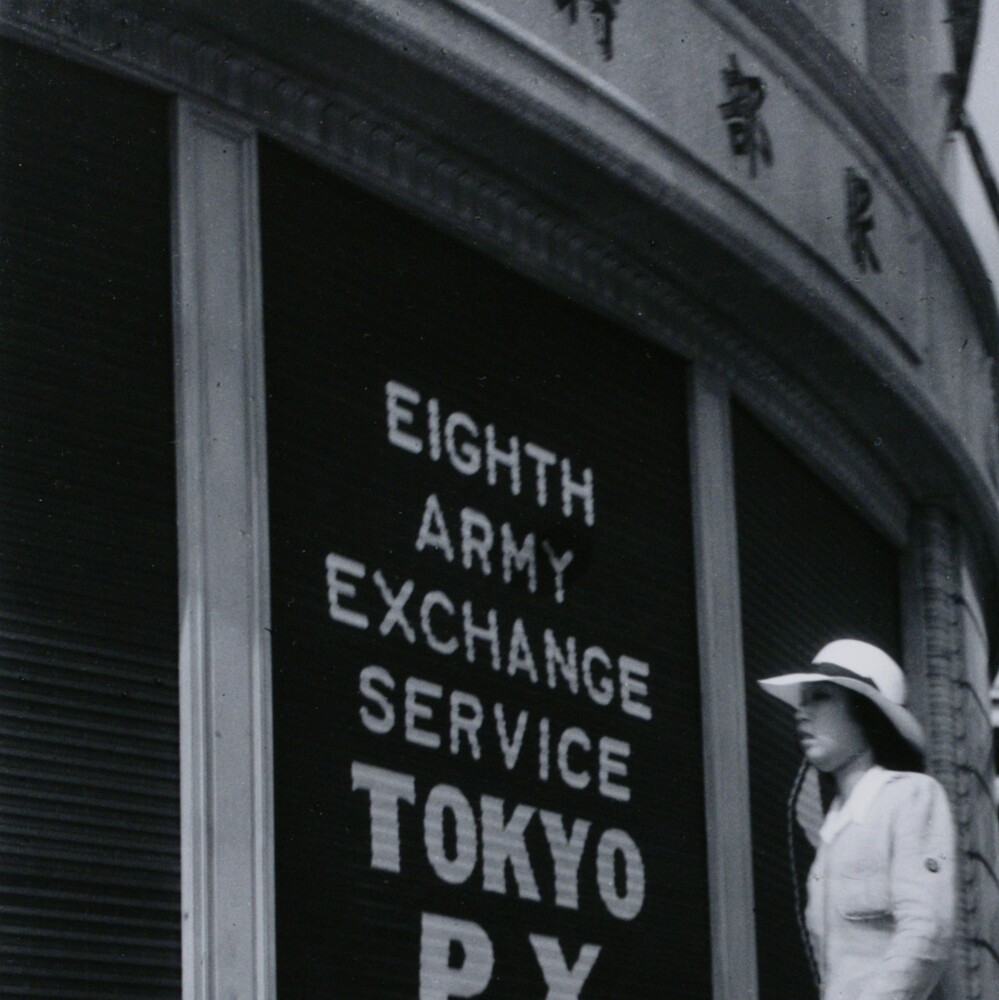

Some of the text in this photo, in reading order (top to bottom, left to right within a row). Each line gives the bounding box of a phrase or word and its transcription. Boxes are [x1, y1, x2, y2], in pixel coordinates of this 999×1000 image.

[384, 379, 595, 527] EIGHTH
[415, 493, 574, 604] ARMY
[325, 552, 653, 721] EXCHANGE
[358, 664, 632, 802] SERVICE
[350, 761, 646, 921] TOKYO
